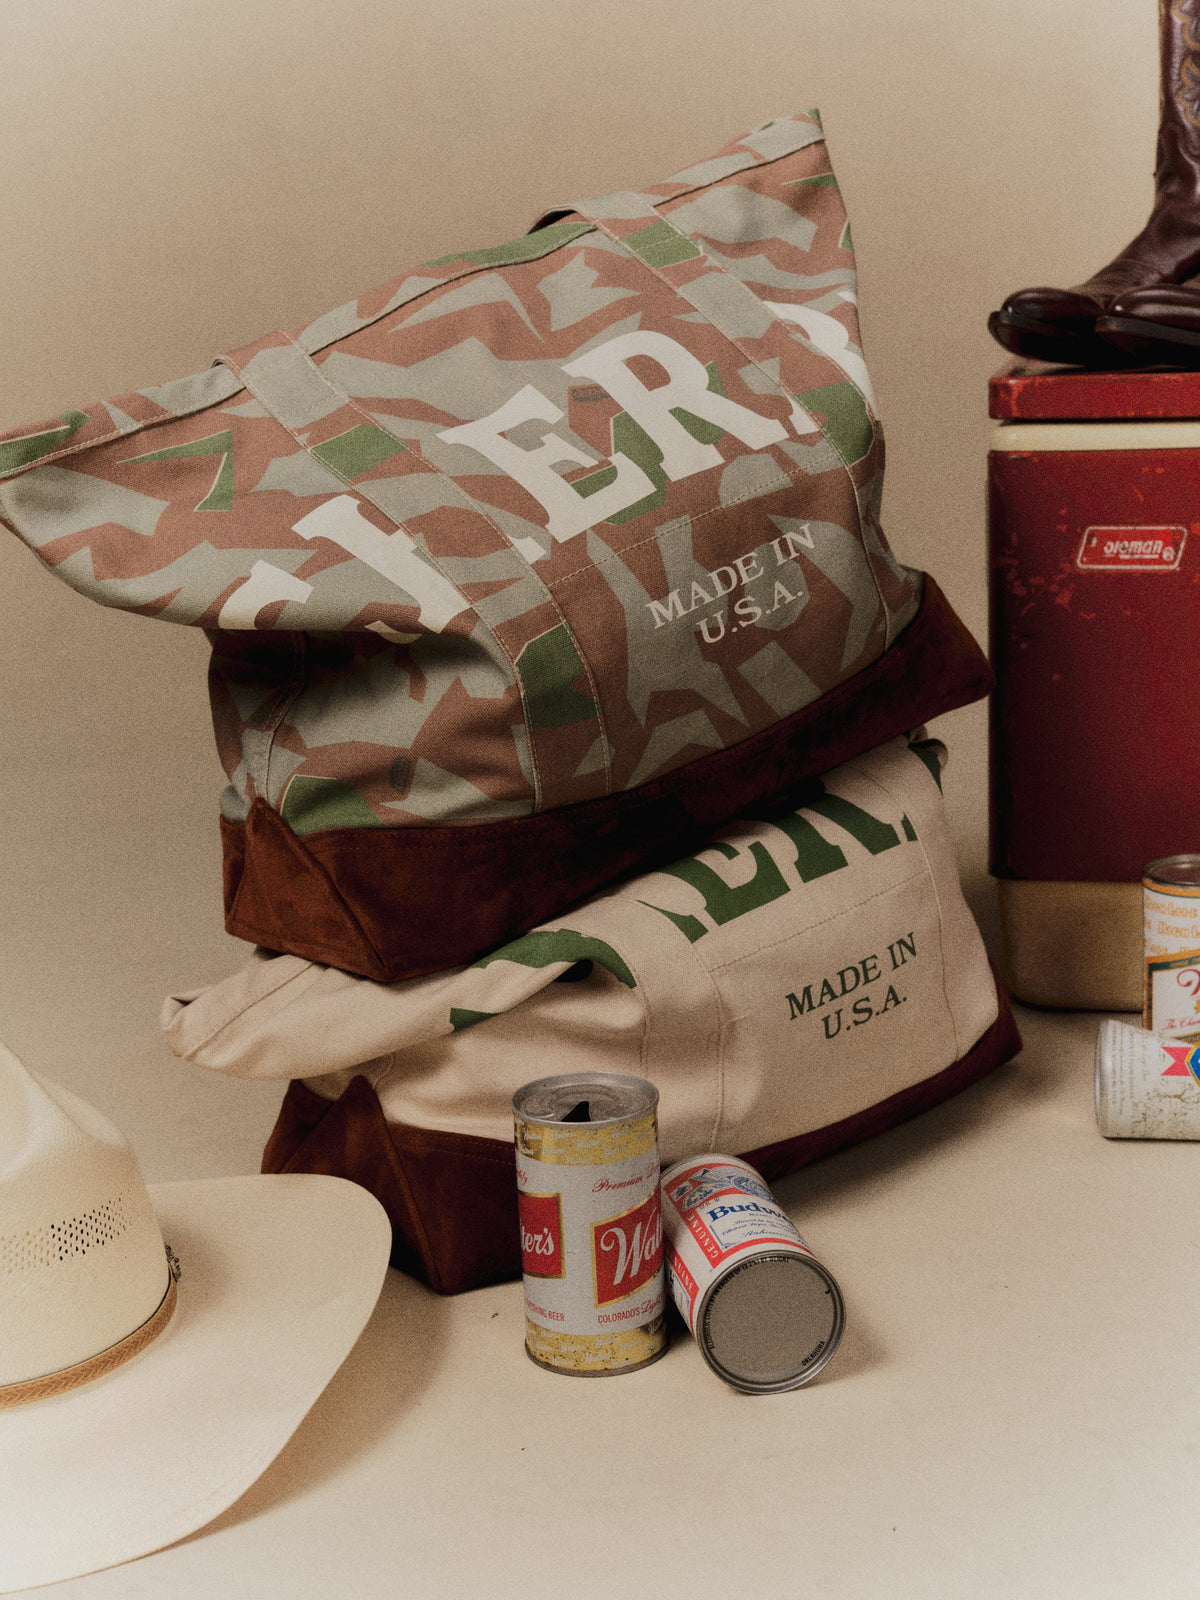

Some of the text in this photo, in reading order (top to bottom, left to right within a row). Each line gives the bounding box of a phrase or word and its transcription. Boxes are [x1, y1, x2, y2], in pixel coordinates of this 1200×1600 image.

[1091, 537, 1163, 554] oleman
[645, 523, 815, 629] MADE IN
[696, 581, 803, 643] U.S.A.
[785, 931, 917, 1021] MADE IN
[822, 985, 907, 1039] U.S.A.
[592, 1175, 644, 1193] Premium
[686, 1213, 719, 1259] GENUINE
[548, 1311, 565, 1323] BEER
[598, 1306, 641, 1324] COLORADO'S
[801, 1341, 825, 1366] OKLAHOMA
